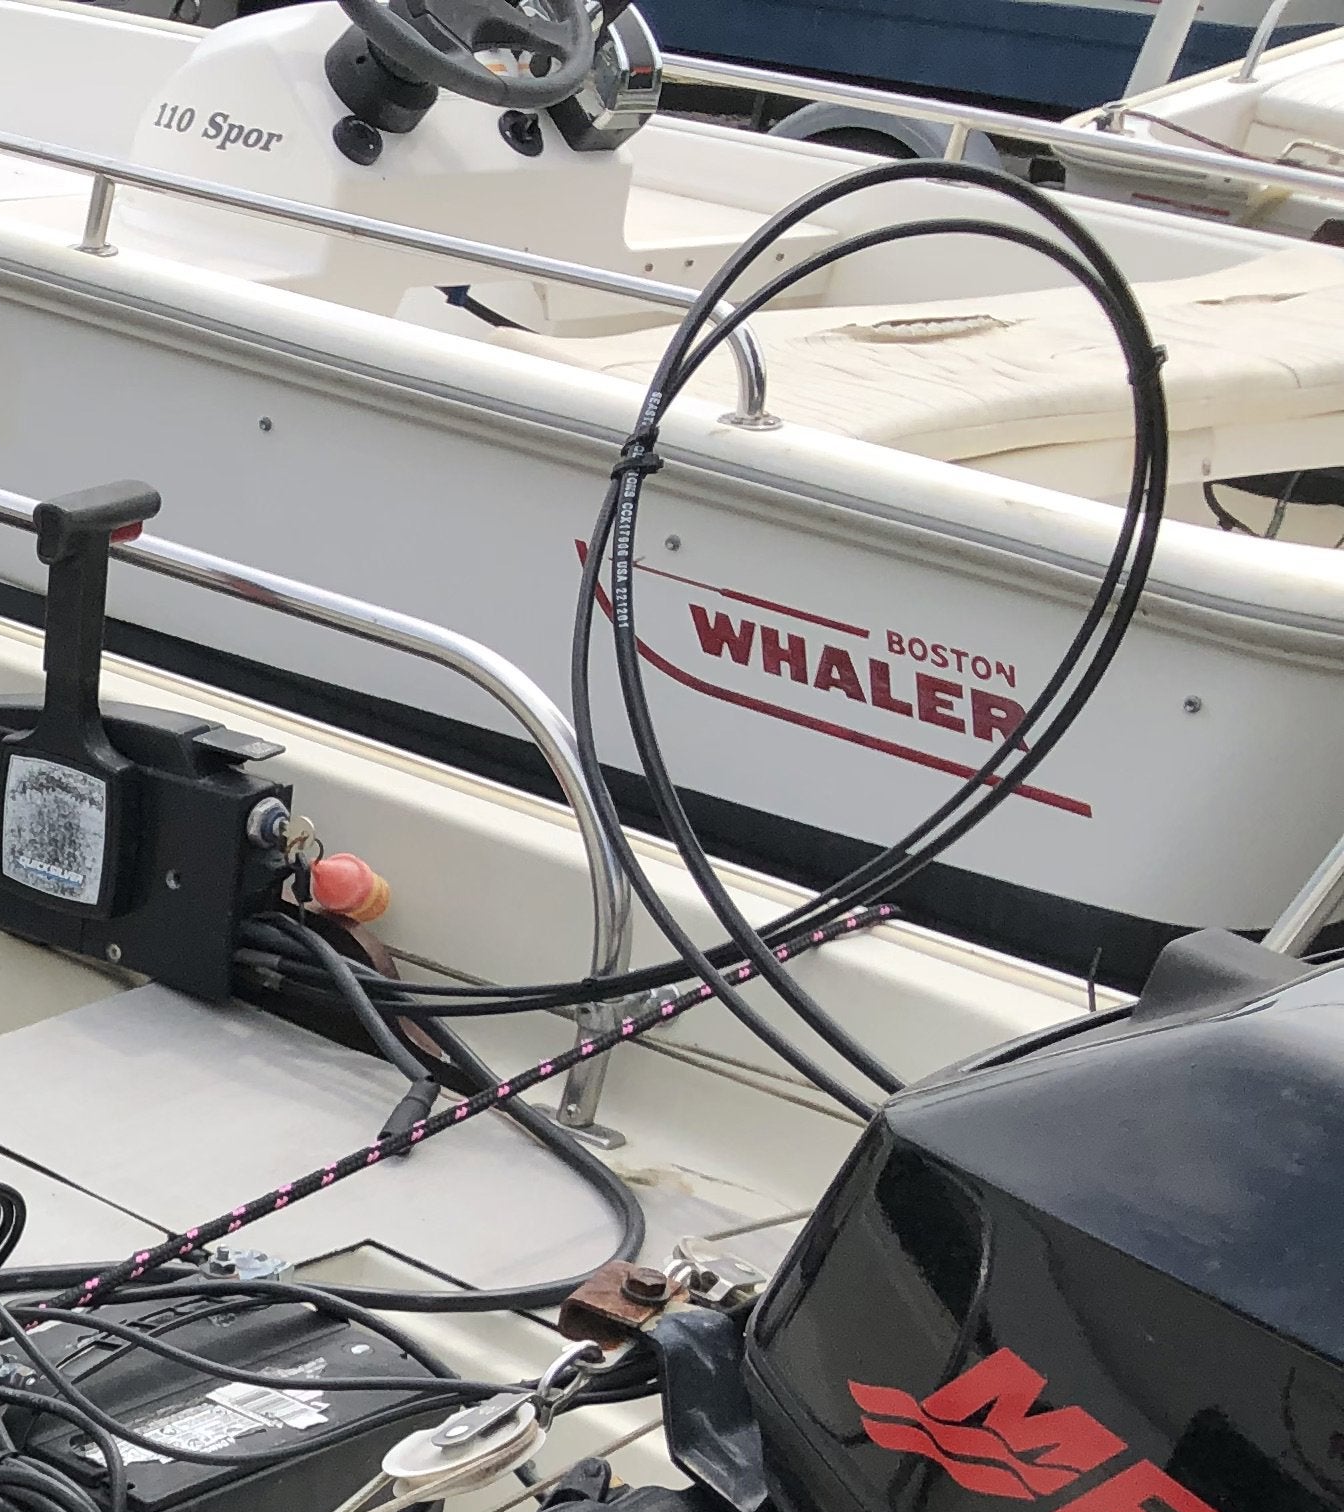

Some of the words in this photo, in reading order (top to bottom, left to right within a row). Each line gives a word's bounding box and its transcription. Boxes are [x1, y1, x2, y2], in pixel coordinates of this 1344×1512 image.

[153, 102, 196, 133] 110
[200, 111, 284, 152] Spor
[616, 561, 628, 583] USA
[688, 603, 1031, 755] WHALER
[885, 628, 1016, 688] BOSTON
